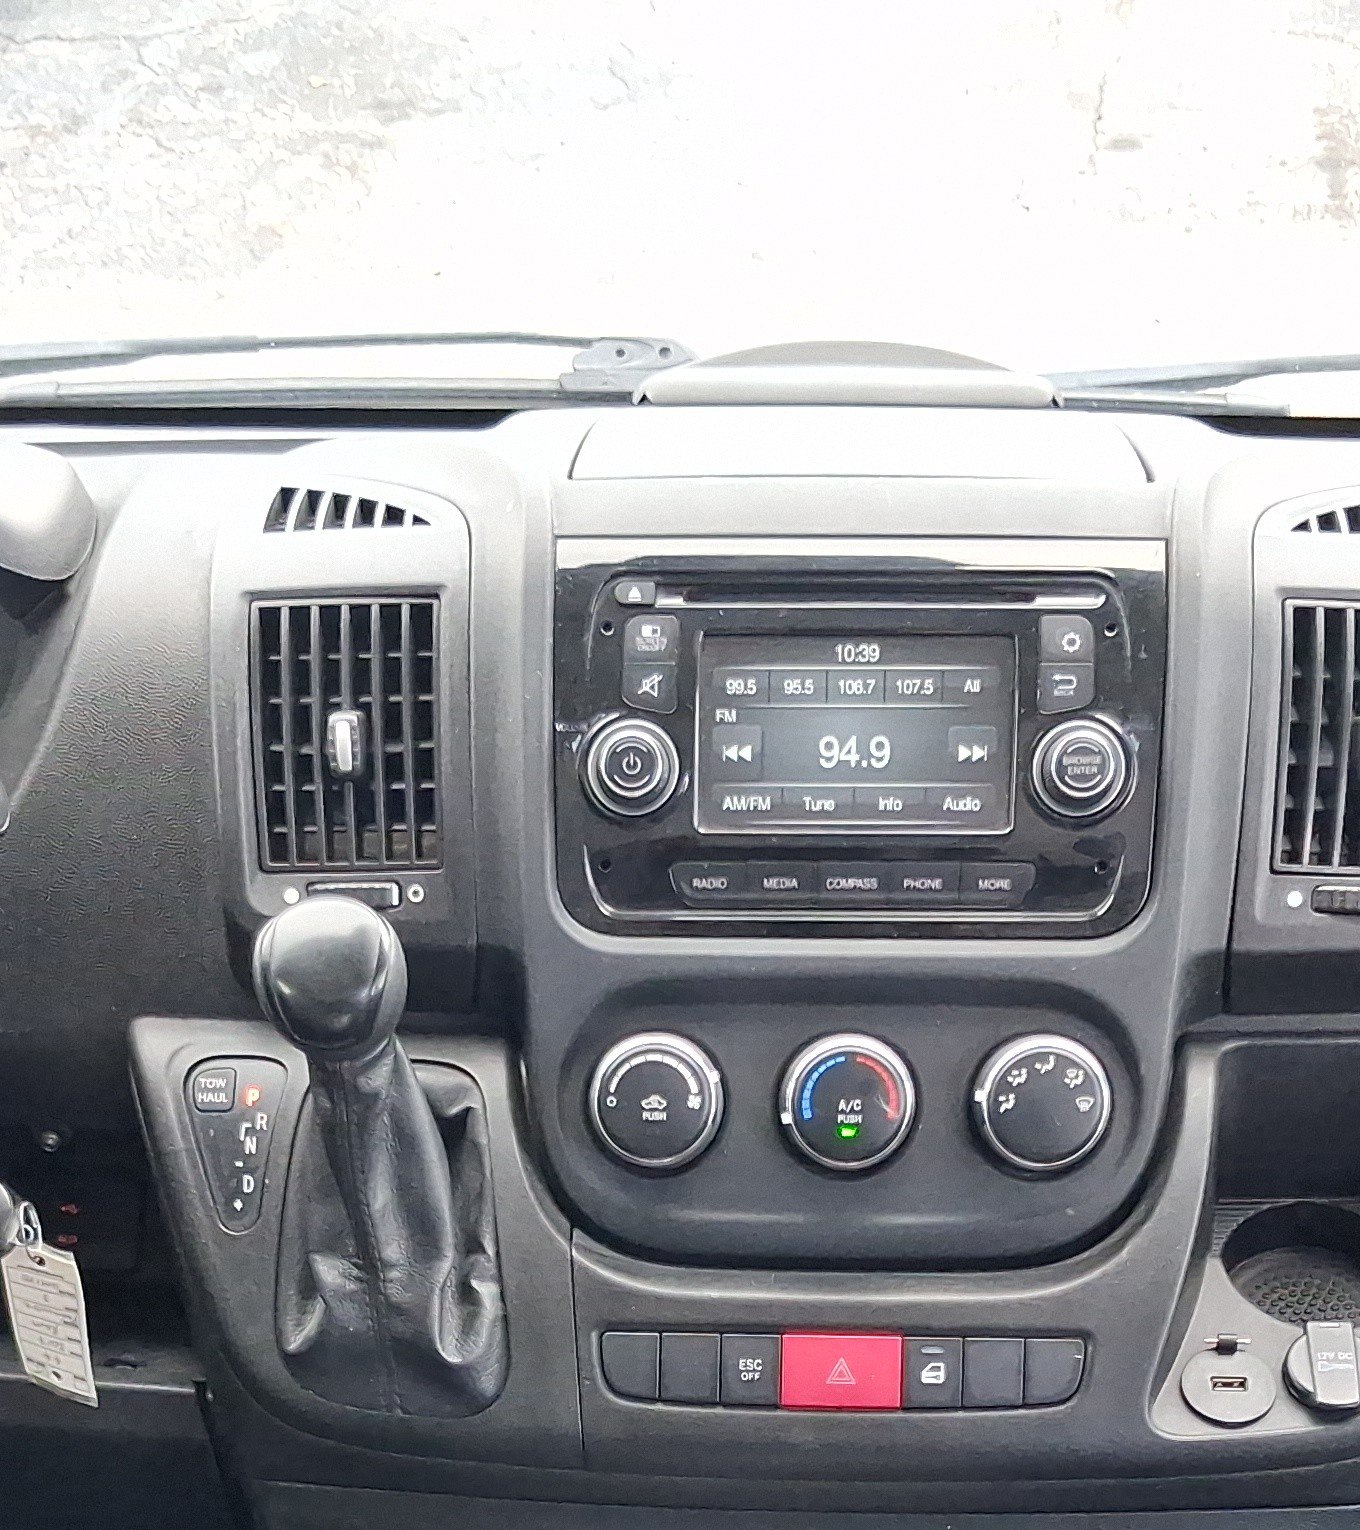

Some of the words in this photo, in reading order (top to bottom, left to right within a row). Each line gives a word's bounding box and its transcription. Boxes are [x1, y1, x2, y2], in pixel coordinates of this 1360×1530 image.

[835, 644, 880, 663] 10:39
[725, 679, 757, 695] 99.5
[783, 679, 814, 695] 95.5
[838, 679, 876, 694] 106.7
[896, 679, 934, 694] 107.5
[715, 709, 737, 723] FM
[819, 735, 891, 769] 94.9
[1067, 765, 1099, 775] ENTER
[722, 796, 771, 811] AM/FM
[803, 796, 835, 811] Tune
[878, 796, 903, 811] Info
[943, 796, 982, 811] Audio
[692, 878, 727, 889] RADIO
[762, 877, 798, 889] MEDIA
[825, 877, 878, 890] COMPASS
[903, 878, 943, 890] PHONE
[978, 878, 1011, 890] MORE
[199, 1078, 227, 1088] TOW
[198, 1092, 229, 1103] HAUL
[245, 1087, 260, 1107] P
[838, 1099, 862, 1112] A/C
[256, 1112, 268, 1131] R
[837, 1114, 863, 1124] PUSH
[244, 1135, 257, 1155] N
[242, 1174, 255, 1194] D
[738, 1358, 763, 1371] ESC
[740, 1371, 761, 1381] OFF
